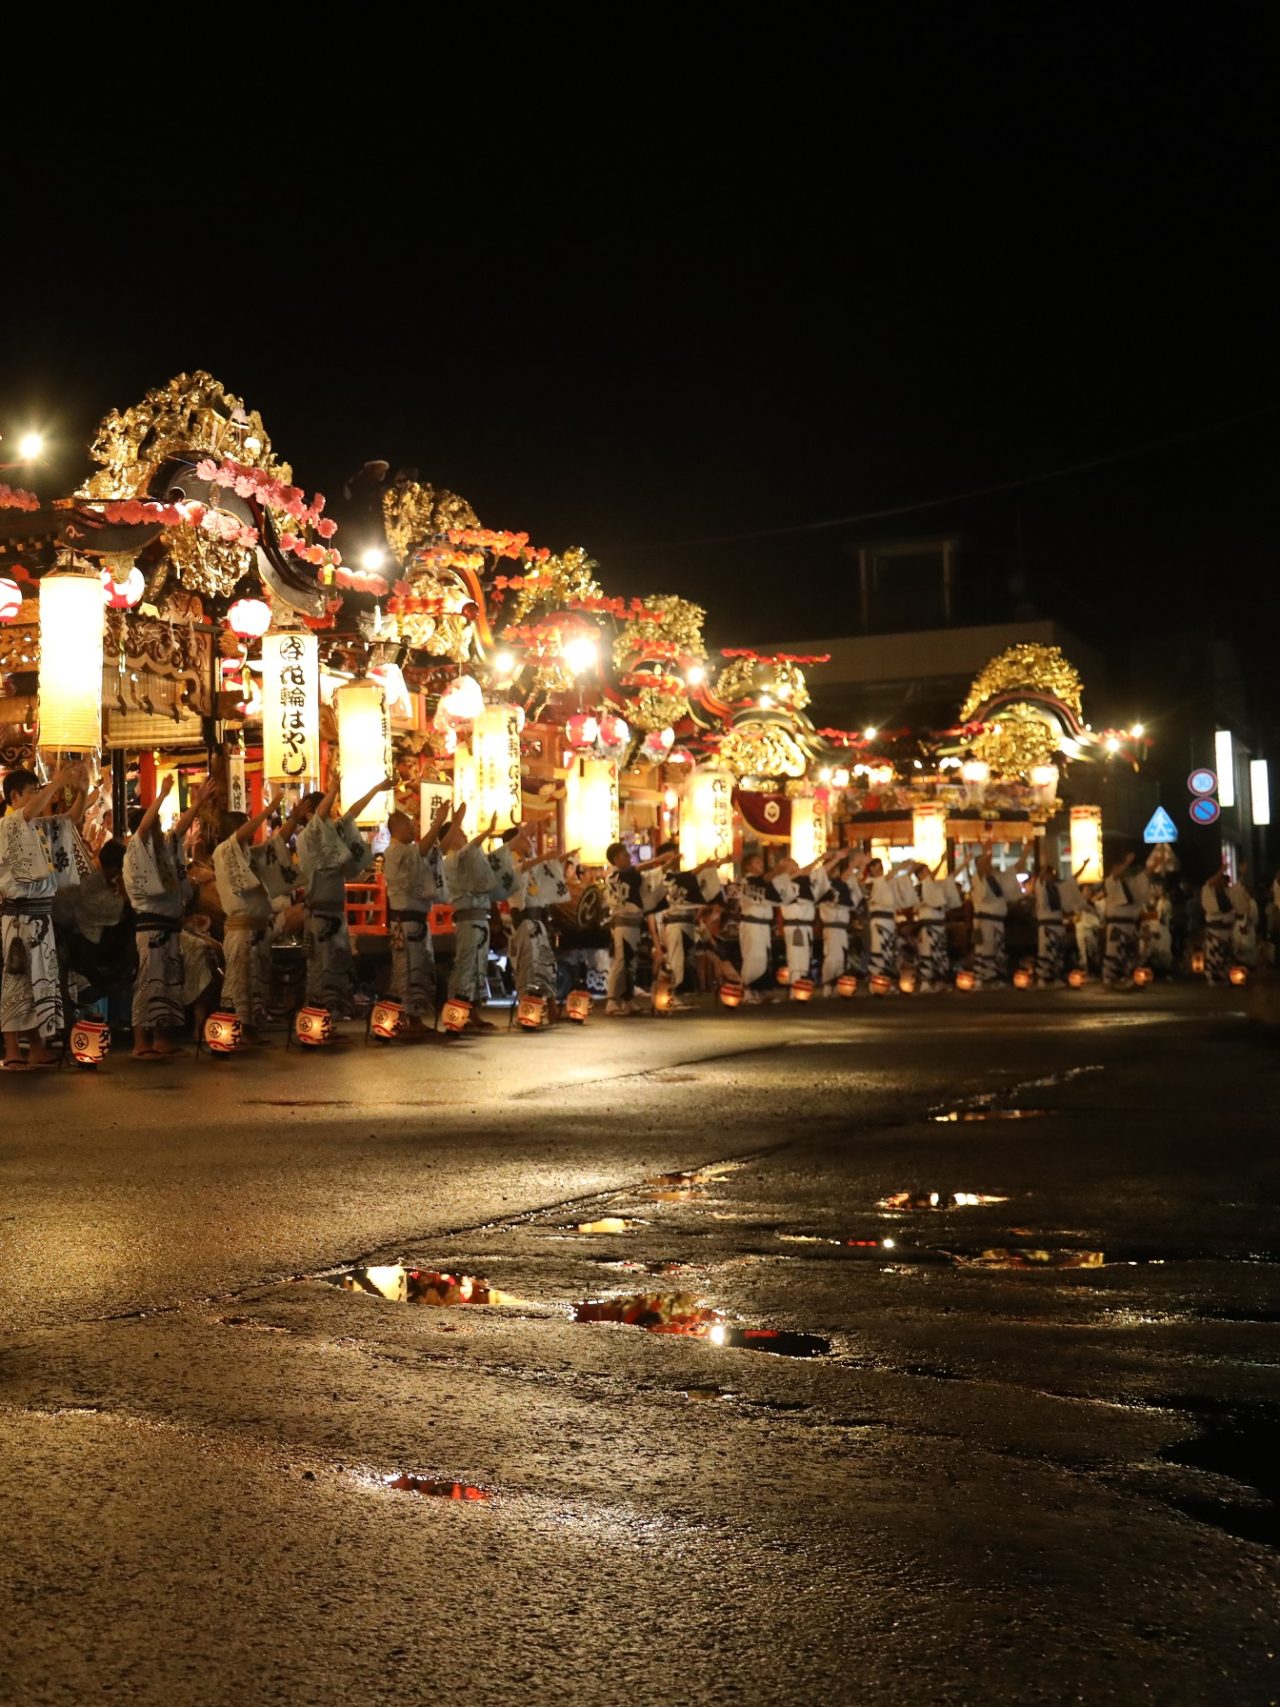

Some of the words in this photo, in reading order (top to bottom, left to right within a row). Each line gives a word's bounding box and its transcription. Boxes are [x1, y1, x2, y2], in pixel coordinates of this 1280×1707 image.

[280, 664, 307, 776] 花輪はやし
